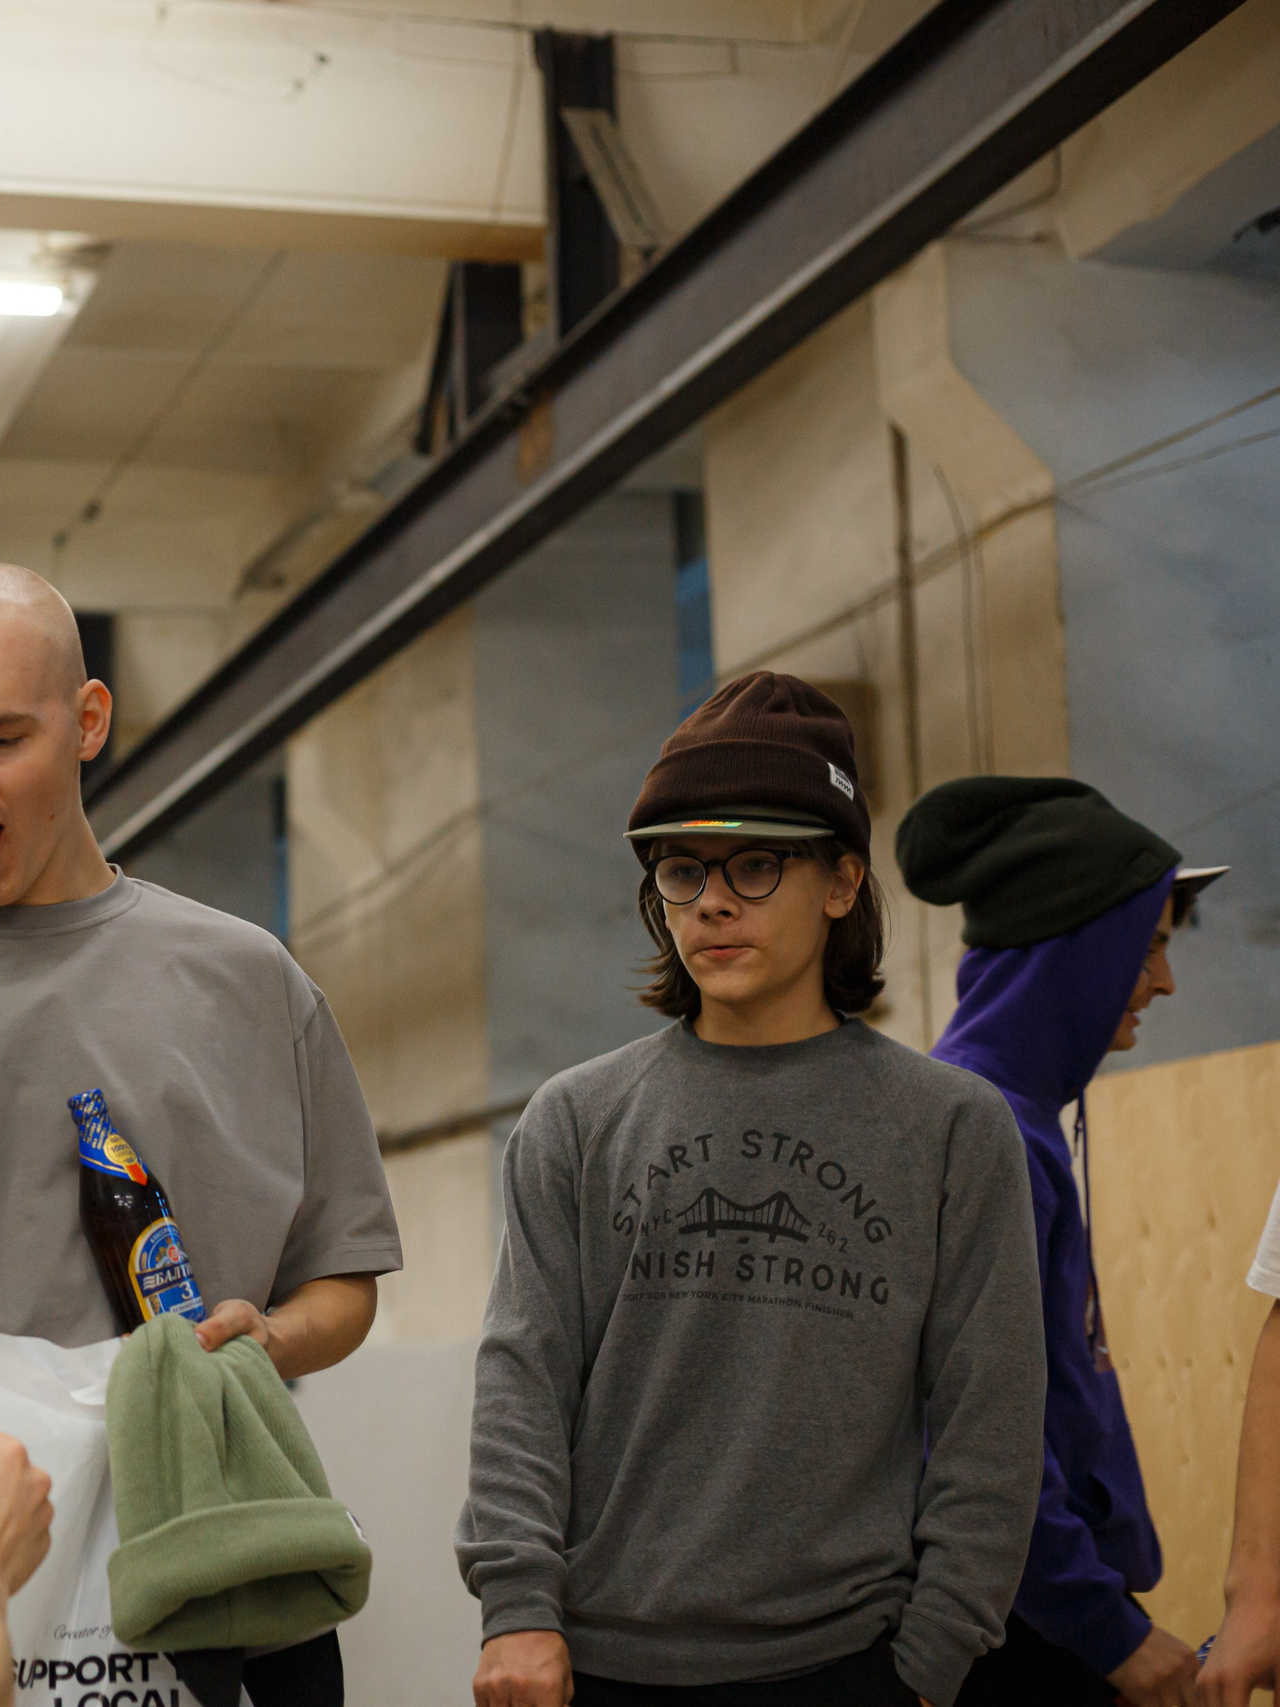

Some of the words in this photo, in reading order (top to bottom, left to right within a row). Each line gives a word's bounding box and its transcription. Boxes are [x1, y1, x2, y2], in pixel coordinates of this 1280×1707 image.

[613, 1133, 714, 1237] START
[740, 1130, 893, 1244] STRONG
[640, 1209, 673, 1237] NYC
[179, 1281, 194, 1300] 3
[625, 1251, 715, 1280] NISH
[736, 1254, 889, 1306] STRONG
[668, 1291, 688, 1299] NEW
[690, 1290, 719, 1300] YORK
[721, 1293, 745, 1303] CITY
[747, 1295, 802, 1308] MARATHON
[804, 1301, 855, 1319] FINISHER
[53, 1624, 97, 1640] Creator
